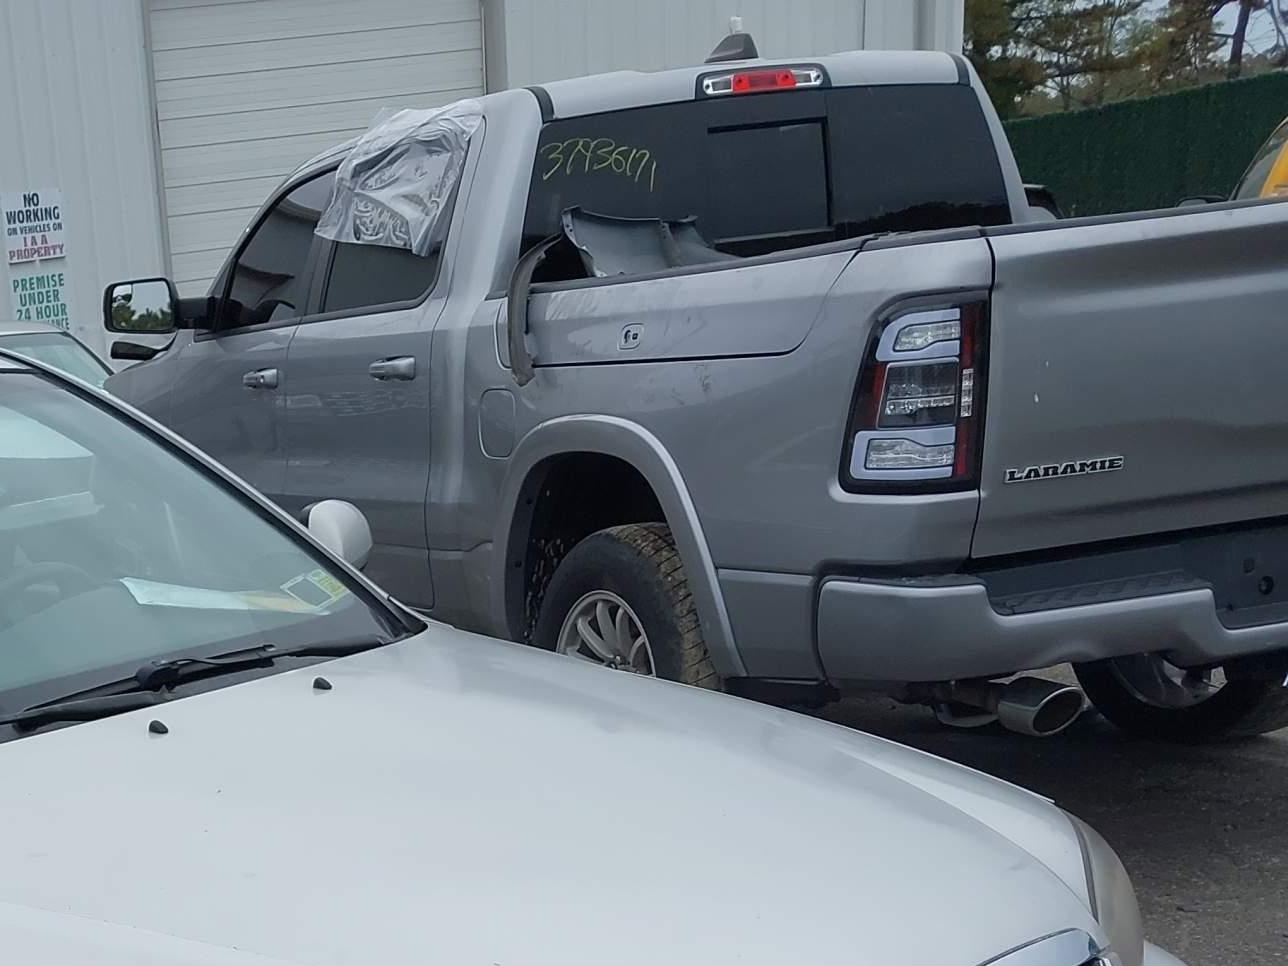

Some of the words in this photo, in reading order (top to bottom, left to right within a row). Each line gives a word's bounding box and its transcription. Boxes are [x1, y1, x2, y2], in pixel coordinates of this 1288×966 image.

[23, 193, 39, 208] NO
[6, 206, 60, 225] WORKING
[7, 227, 17, 236] ON
[19, 223, 51, 235] VEHICLES
[52, 222, 62, 231] ON
[8, 243, 64, 261] PROPERTY
[13, 273, 64, 293] PREMISE
[19, 289, 60, 307] UNDER
[16, 308, 31, 320] 24
[36, 303, 67, 320] HOUR
[1006, 457, 1123, 482] LARAMIE
